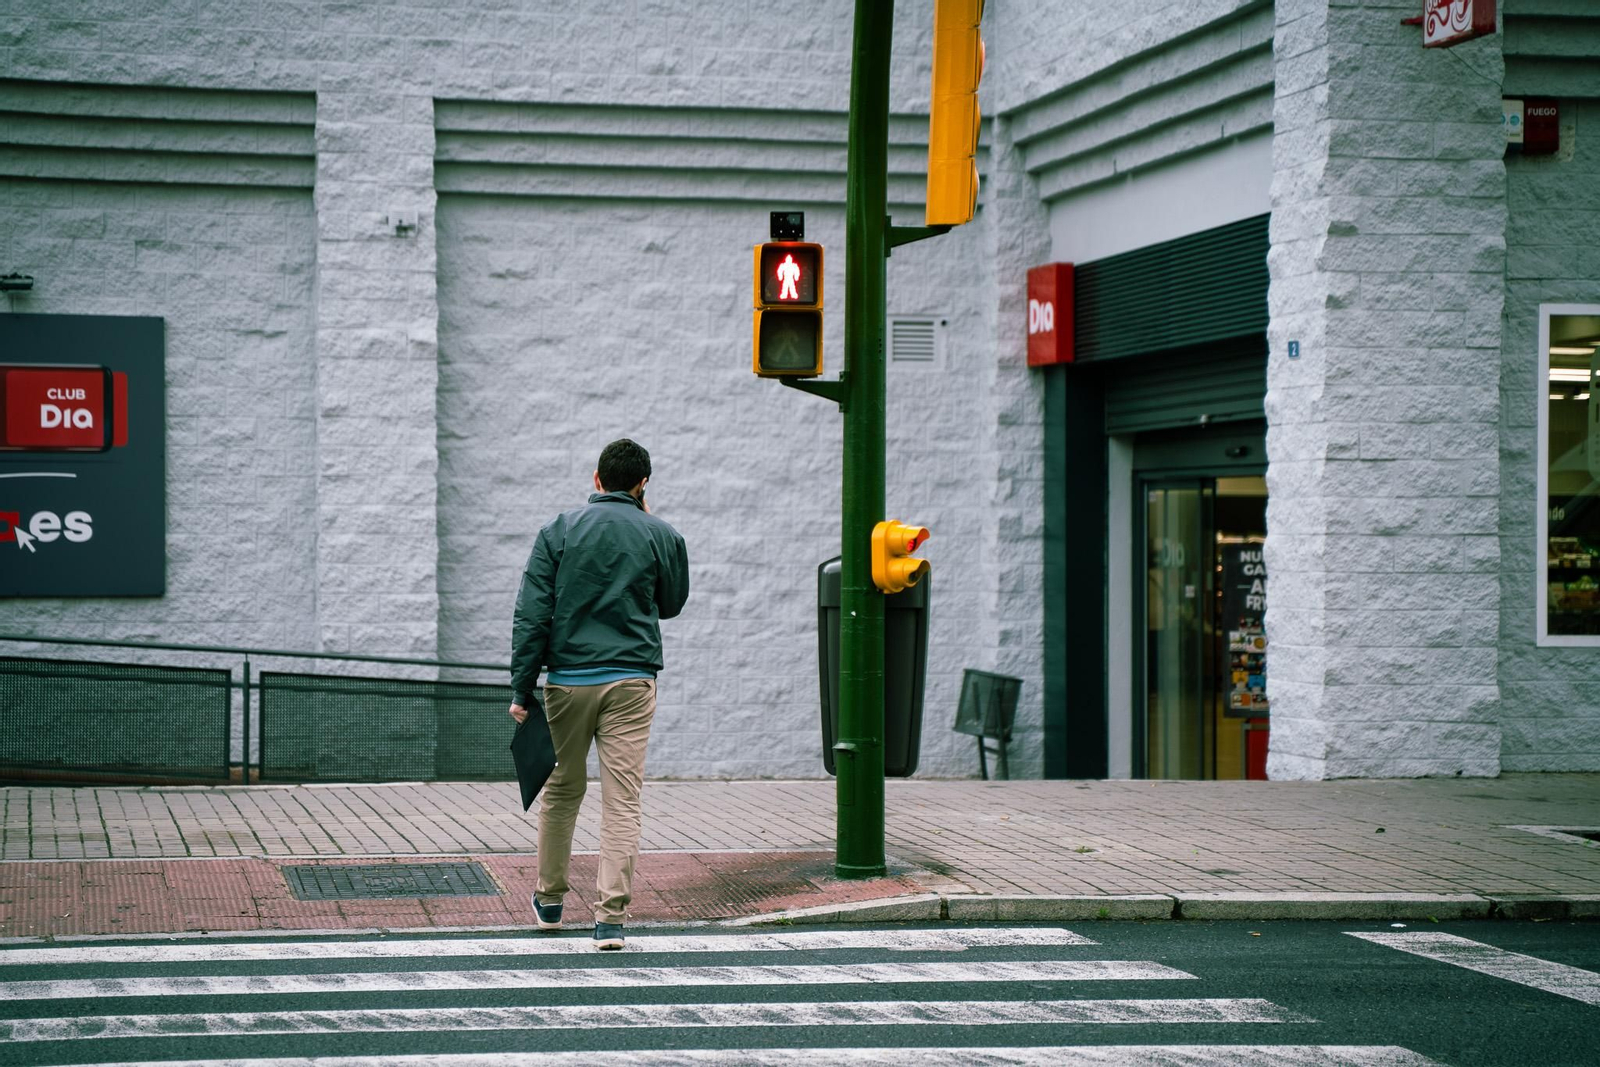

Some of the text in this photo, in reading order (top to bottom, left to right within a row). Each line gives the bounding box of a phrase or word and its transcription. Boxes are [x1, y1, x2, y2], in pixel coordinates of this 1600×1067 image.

[1527, 107, 1557, 116] FUEGO
[1291, 343, 1297, 356] 2
[47, 388, 86, 400] CLUB
[1240, 551, 1263, 563] NU
[1243, 564, 1265, 576] GA
